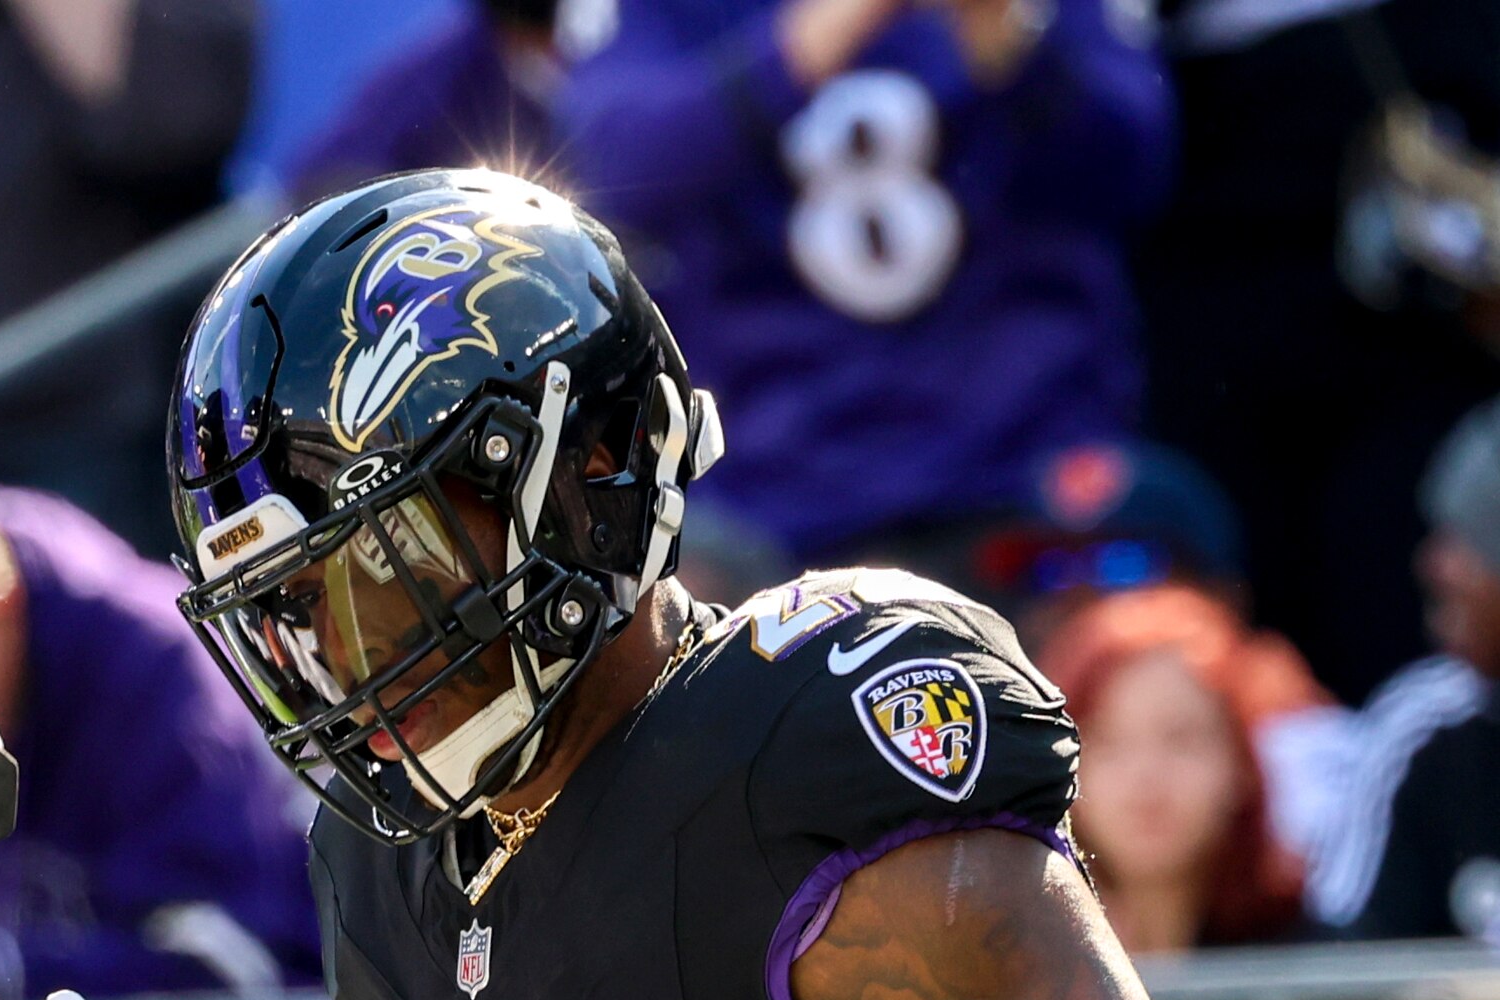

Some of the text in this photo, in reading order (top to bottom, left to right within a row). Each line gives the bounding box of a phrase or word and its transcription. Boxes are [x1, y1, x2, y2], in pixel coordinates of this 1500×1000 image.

[782, 68, 965, 322] 8
[333, 461, 404, 512] OAKLEY
[867, 669, 956, 704] RAVENS
[462, 955, 483, 984] NFL
